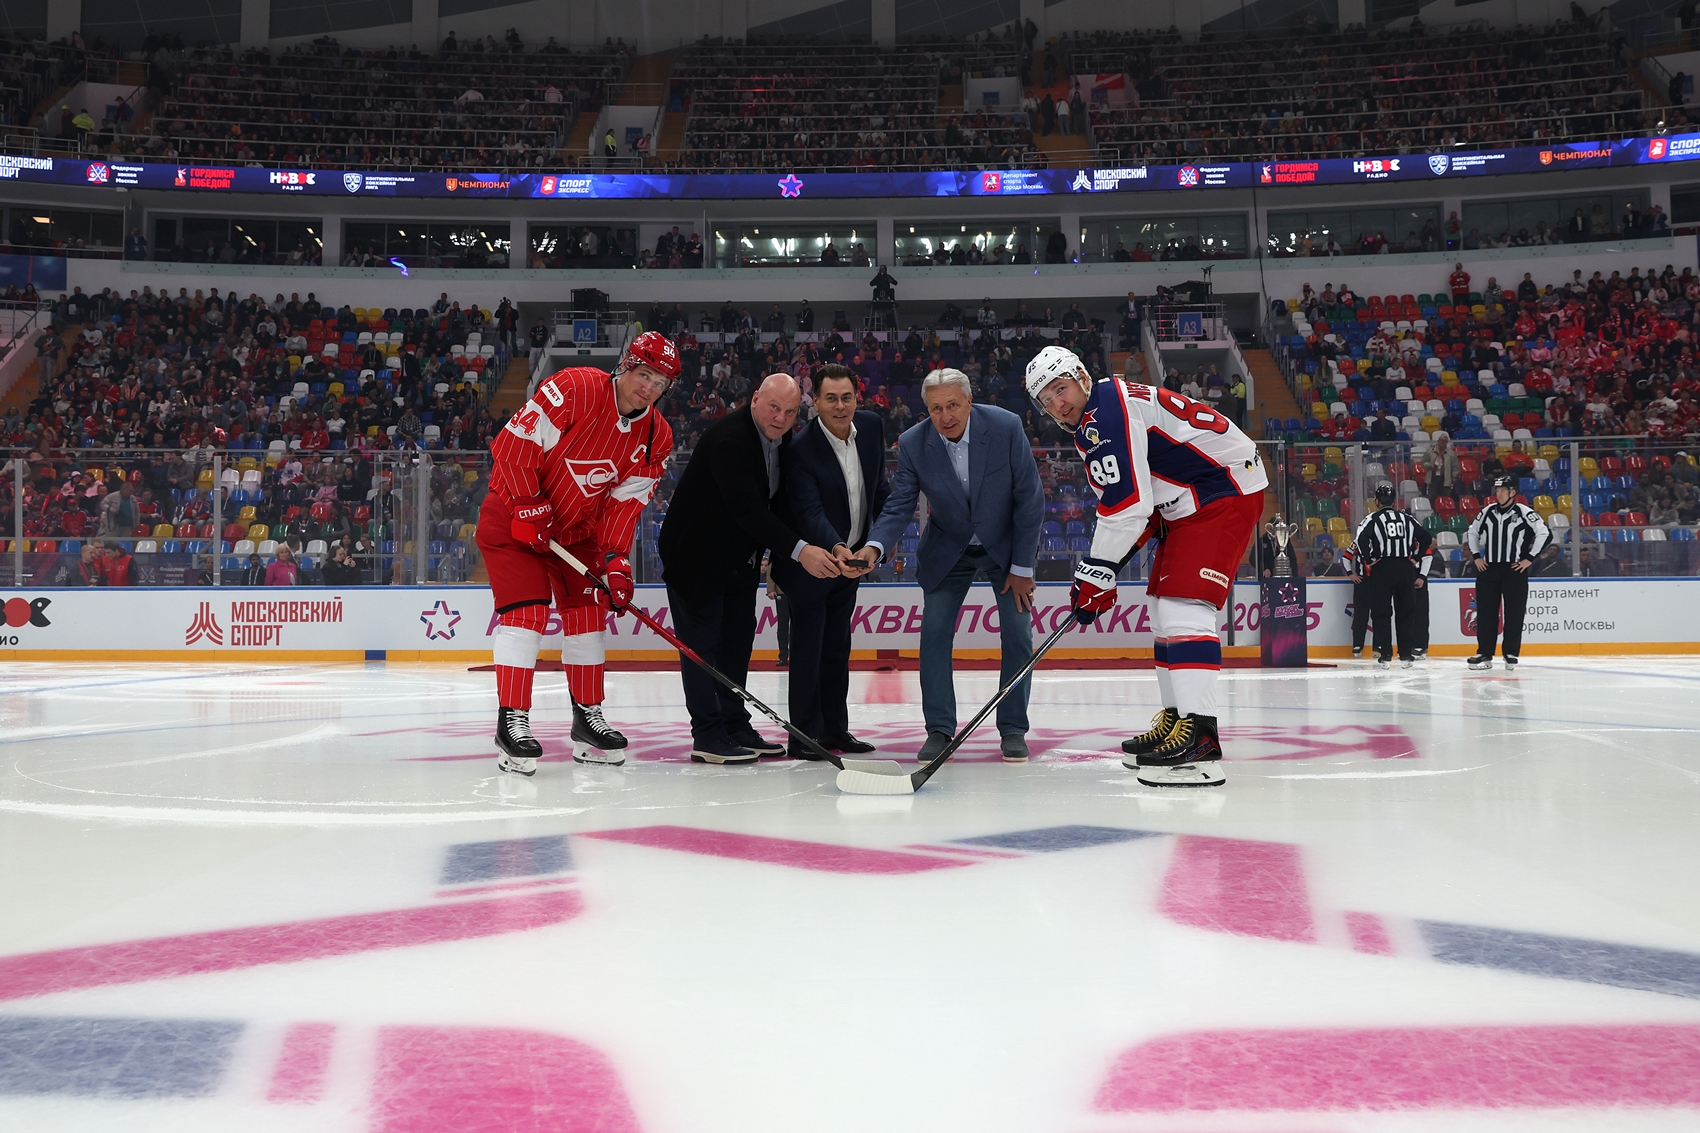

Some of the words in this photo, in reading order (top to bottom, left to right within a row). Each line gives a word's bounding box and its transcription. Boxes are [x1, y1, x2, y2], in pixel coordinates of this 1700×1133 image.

[1554, 149, 1612, 160] ЧЕМПИОНАТ
[111, 164, 144, 172] Федерация
[190, 168, 235, 179] ГОРДИМСЯ
[1094, 166, 1147, 180] МОСКОВСКИЙ
[1275, 163, 1319, 173] ГОРДИМСЯ
[190, 178, 231, 189] ПОБЕДОЙ!
[559, 180, 592, 188] СПОРТ
[1275, 172, 1315, 183] ПОБЕДОЙ!
[459, 181, 510, 189] ЧЕМПИОНАТ
[1094, 180, 1119, 190] СПОРТ
[577, 327, 592, 341] A2
[1183, 321, 1197, 334] A3
[1089, 454, 1121, 486] 89
[1386, 521, 1405, 537] 80
[1527, 588, 1600, 601] партамент
[231, 596, 343, 622] МОСКОВСКИЙ
[1220, 602, 1324, 632] 205
[1522, 621, 1559, 634] орода
[1563, 619, 1615, 631] Москвы
[231, 625, 283, 646] СПОРТ
